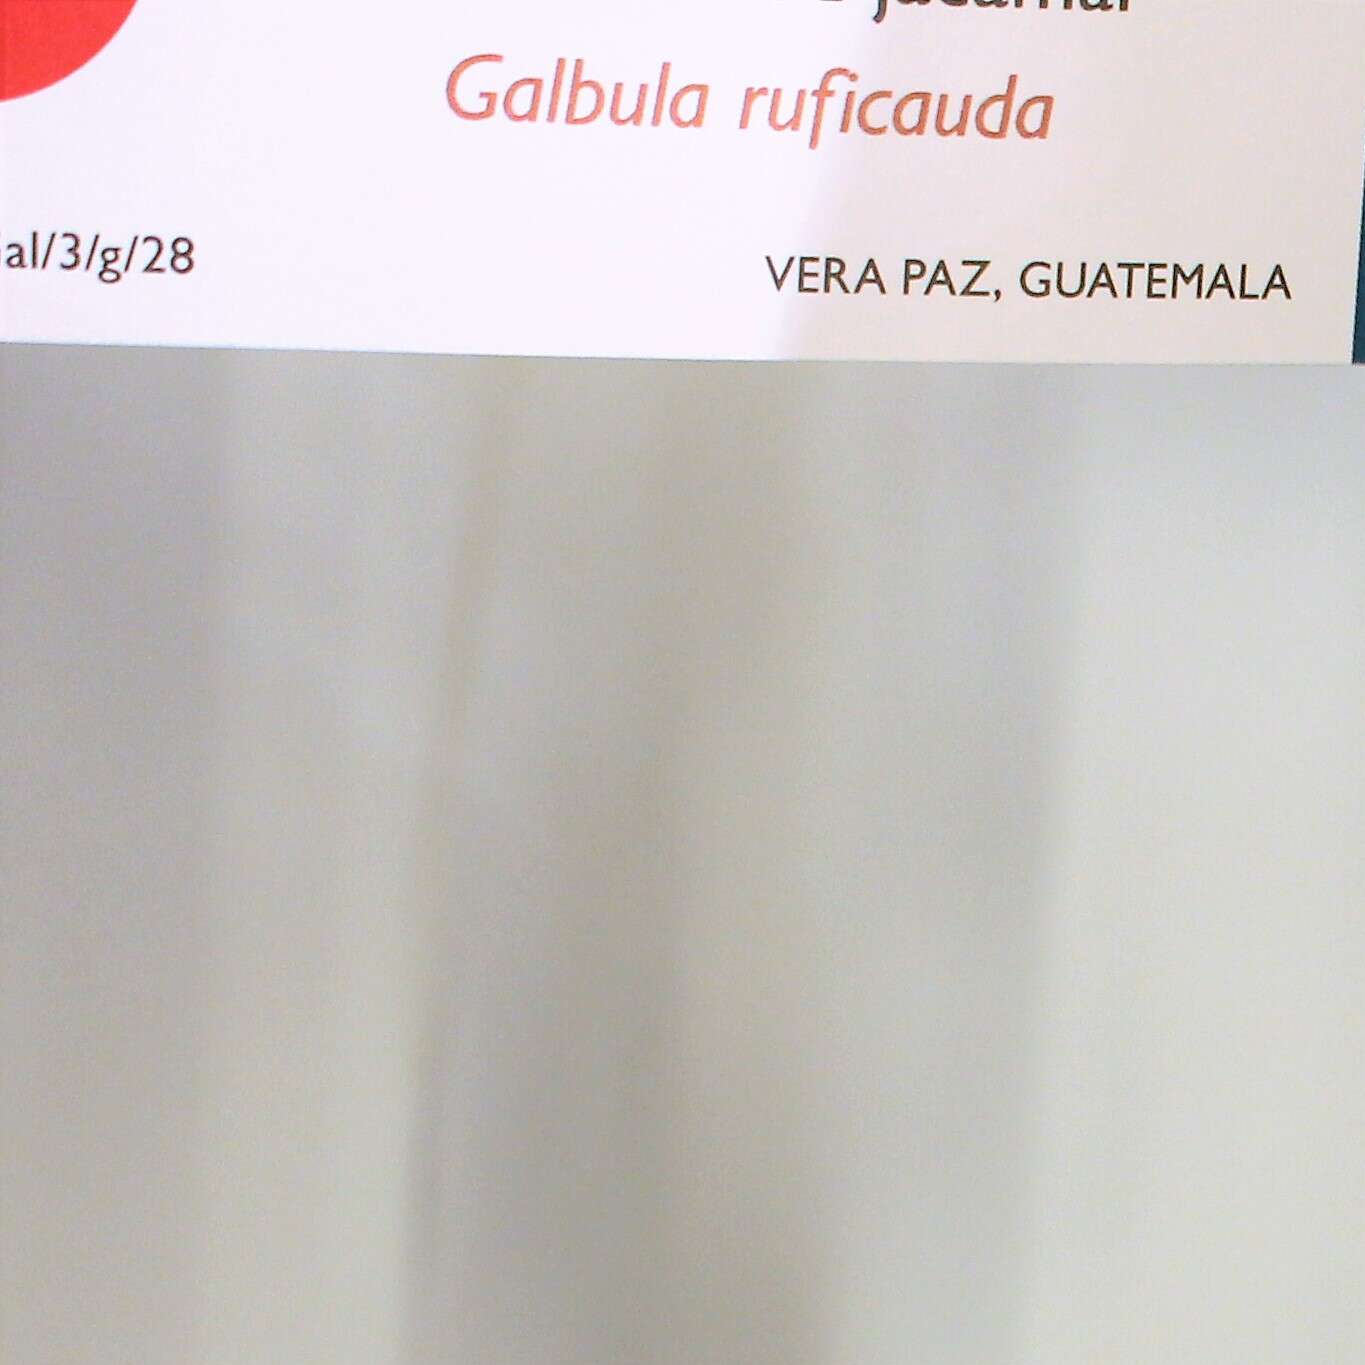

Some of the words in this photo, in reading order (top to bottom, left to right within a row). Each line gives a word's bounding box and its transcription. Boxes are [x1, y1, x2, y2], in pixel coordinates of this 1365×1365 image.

[446, 53, 708, 129] Galbula
[739, 66, 1054, 150] ruficauda
[764, 255, 887, 297] VERA
[902, 258, 1002, 303] PAZ,
[1019, 260, 1292, 301] GUATEMALA
